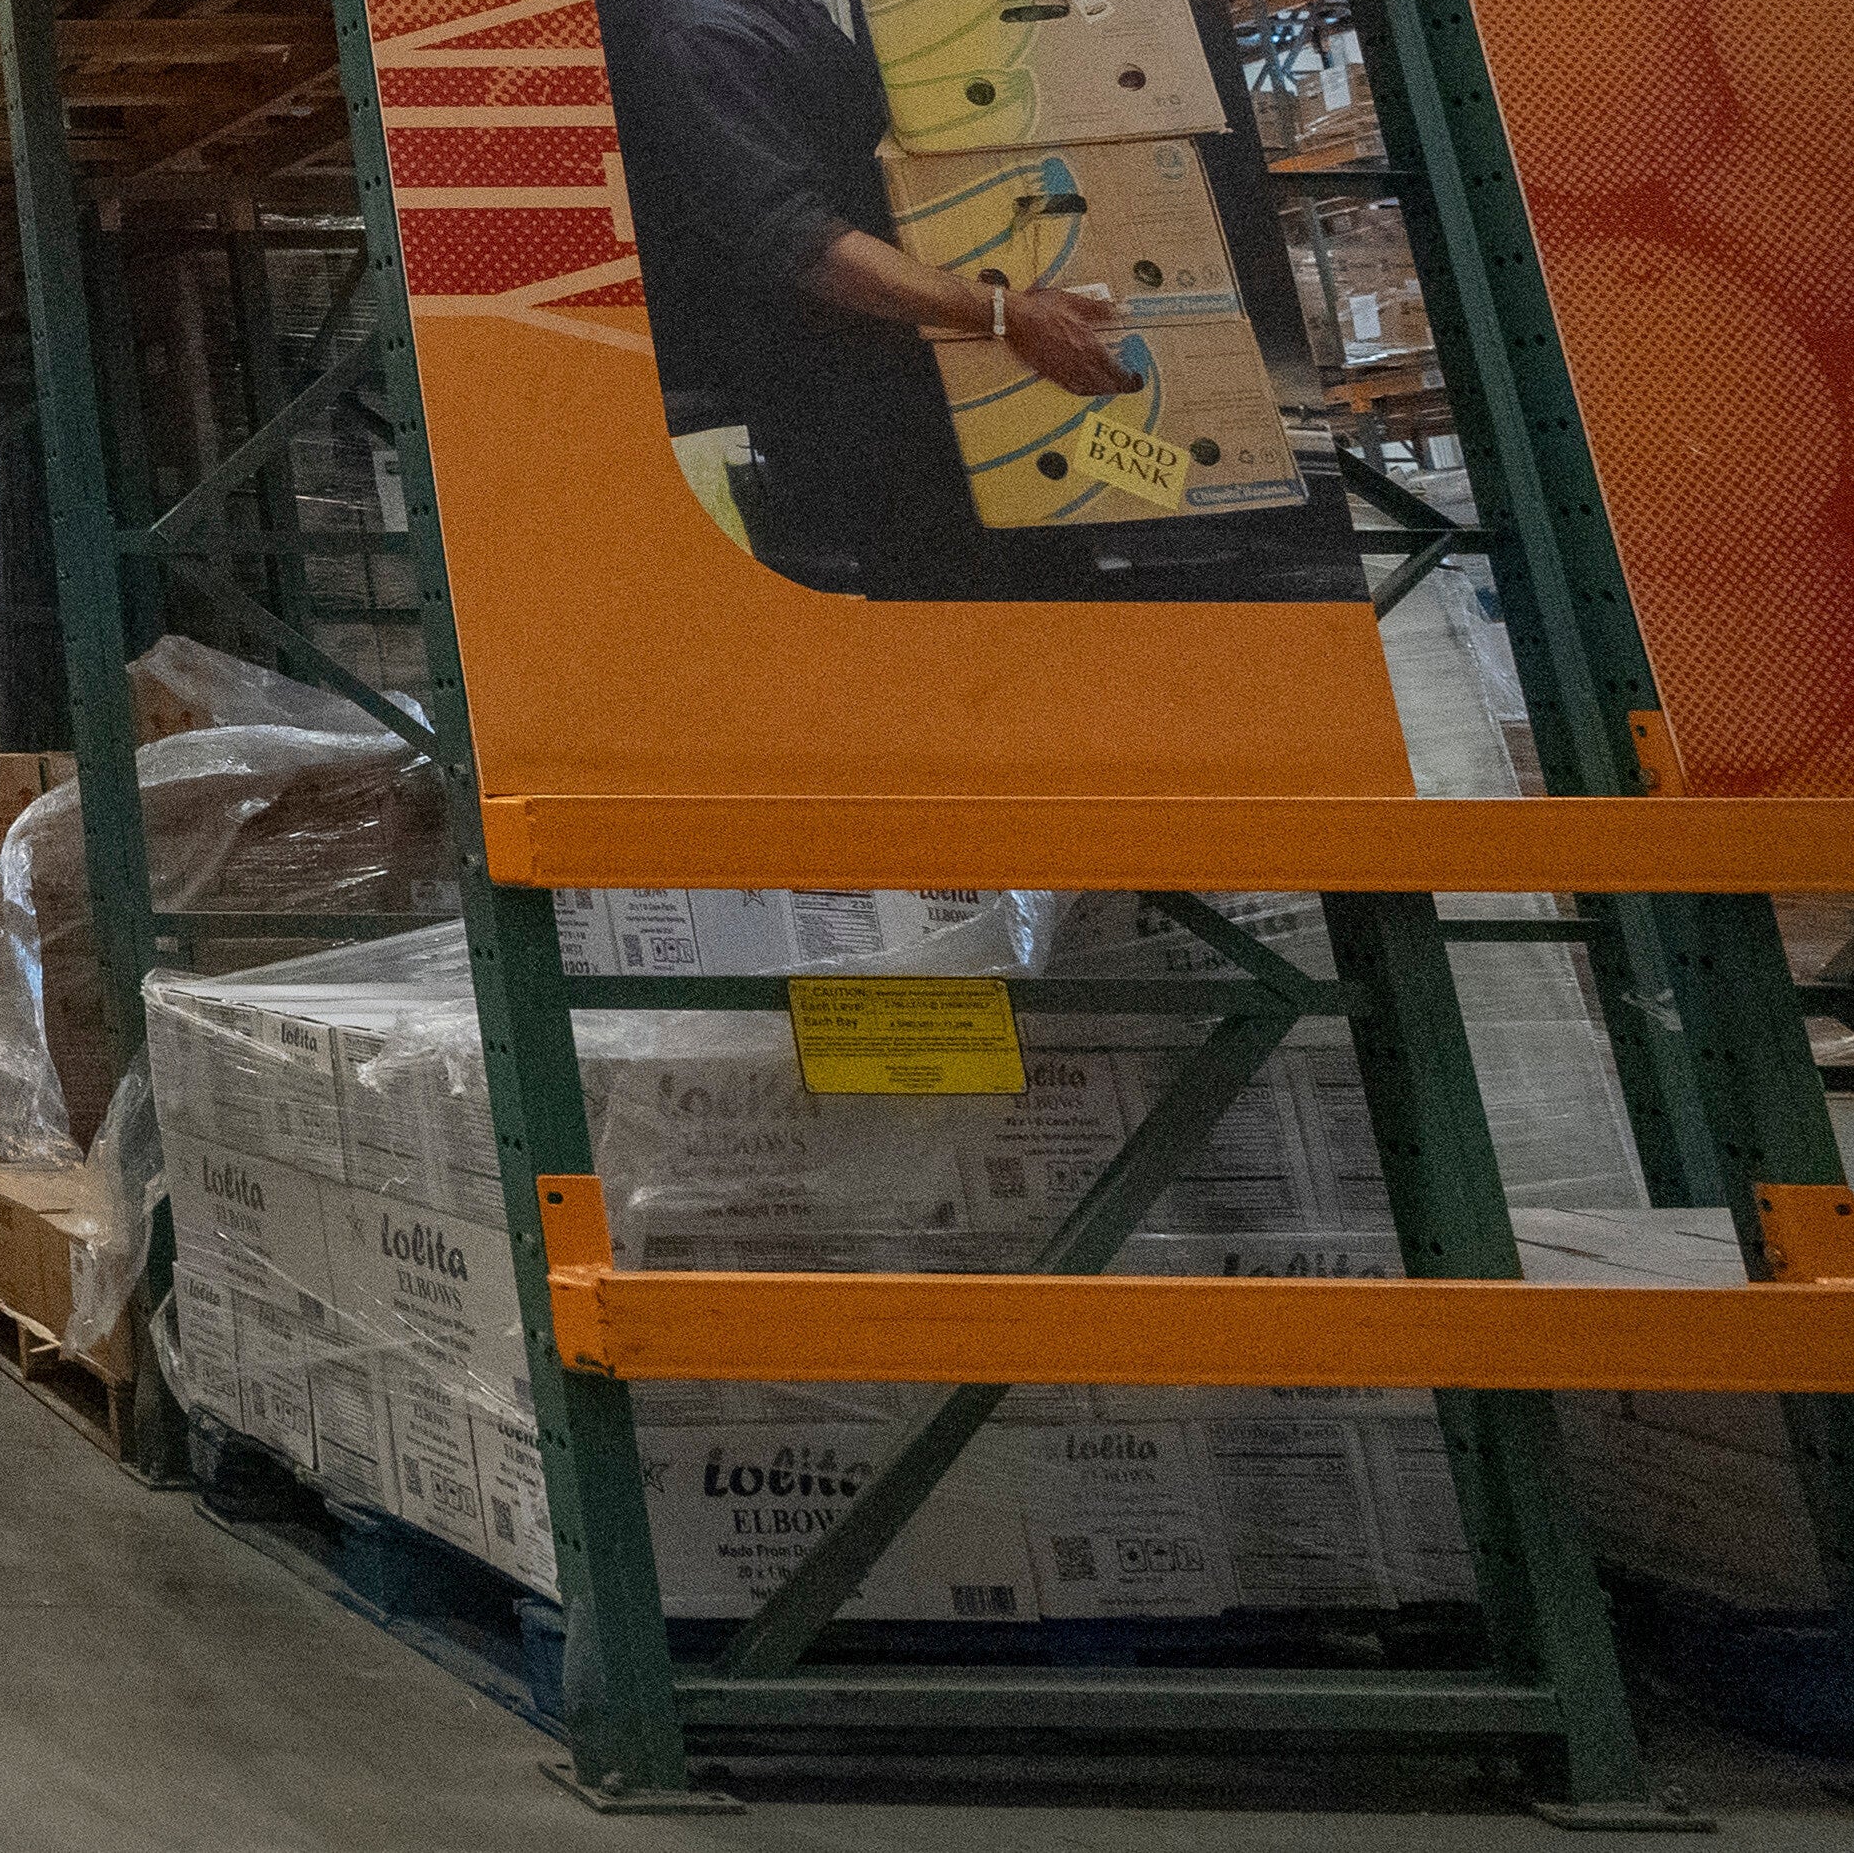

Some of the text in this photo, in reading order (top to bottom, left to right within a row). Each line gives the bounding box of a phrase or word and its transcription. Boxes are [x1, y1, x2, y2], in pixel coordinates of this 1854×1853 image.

[1090, 420, 1178, 469] FOOD
[1086, 439, 1174, 492] BANK
[852, 900, 874, 910] 230
[800, 1000, 830, 1012] Each
[281, 1022, 319, 1053] lolita
[803, 1016, 833, 1028] Each
[202, 1155, 266, 1212] lolita
[380, 1212, 469, 1282] lolita
[396, 1268, 464, 1312] ELBOWS
[1066, 1433, 1159, 1463] lolita
[704, 1446, 874, 1498] lolita
[731, 1508, 842, 1535] ELBOW
[718, 1544, 753, 1558] Made
